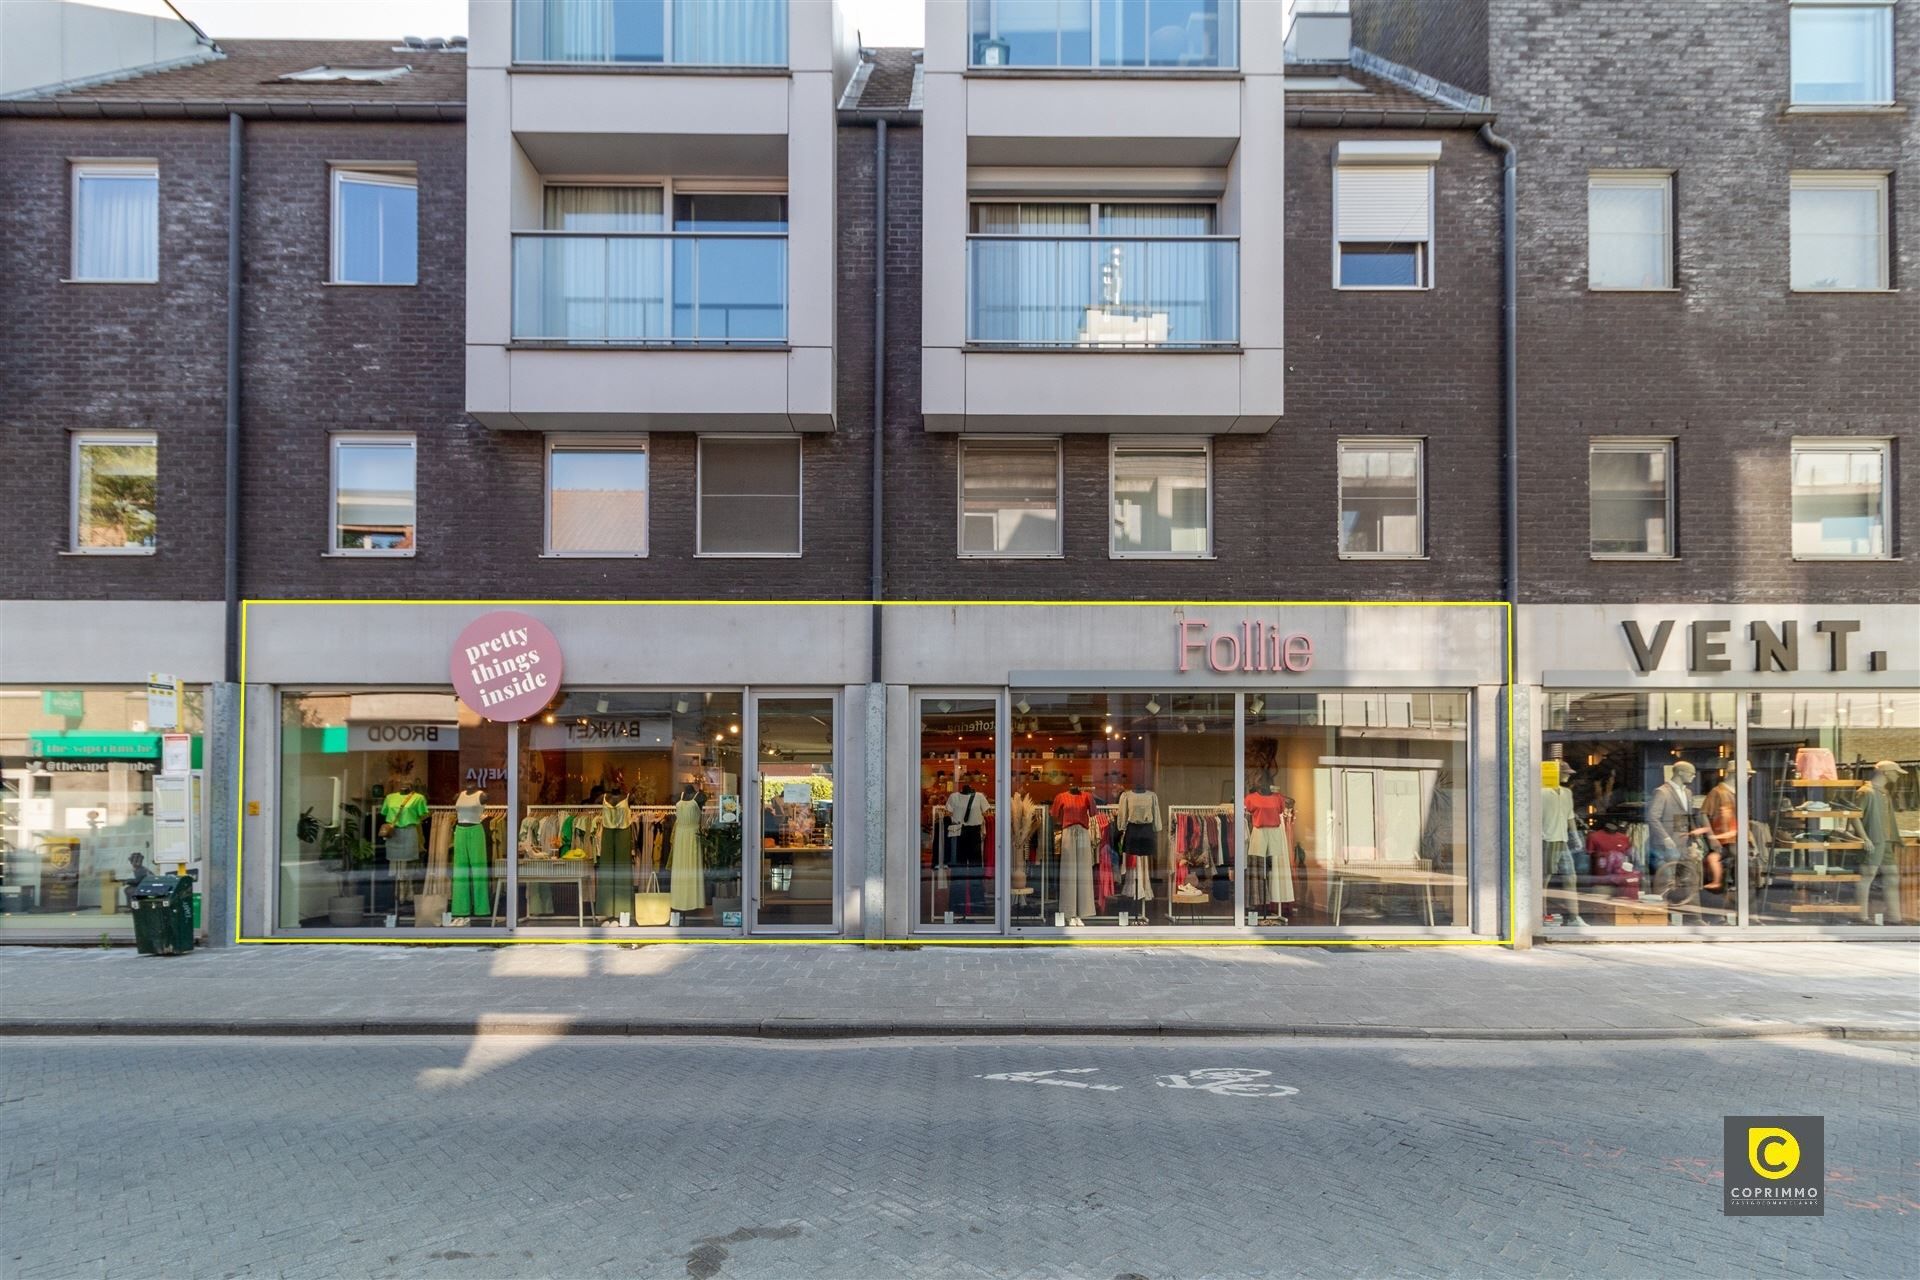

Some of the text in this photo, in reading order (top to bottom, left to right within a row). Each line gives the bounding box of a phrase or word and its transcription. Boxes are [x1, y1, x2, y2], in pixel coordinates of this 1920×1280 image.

[465, 627, 528, 665] pretty
[1179, 618, 1314, 673] Follie
[1621, 619, 1887, 672] VENT.
[471, 649, 540, 685] things
[480, 671, 548, 708] inside
